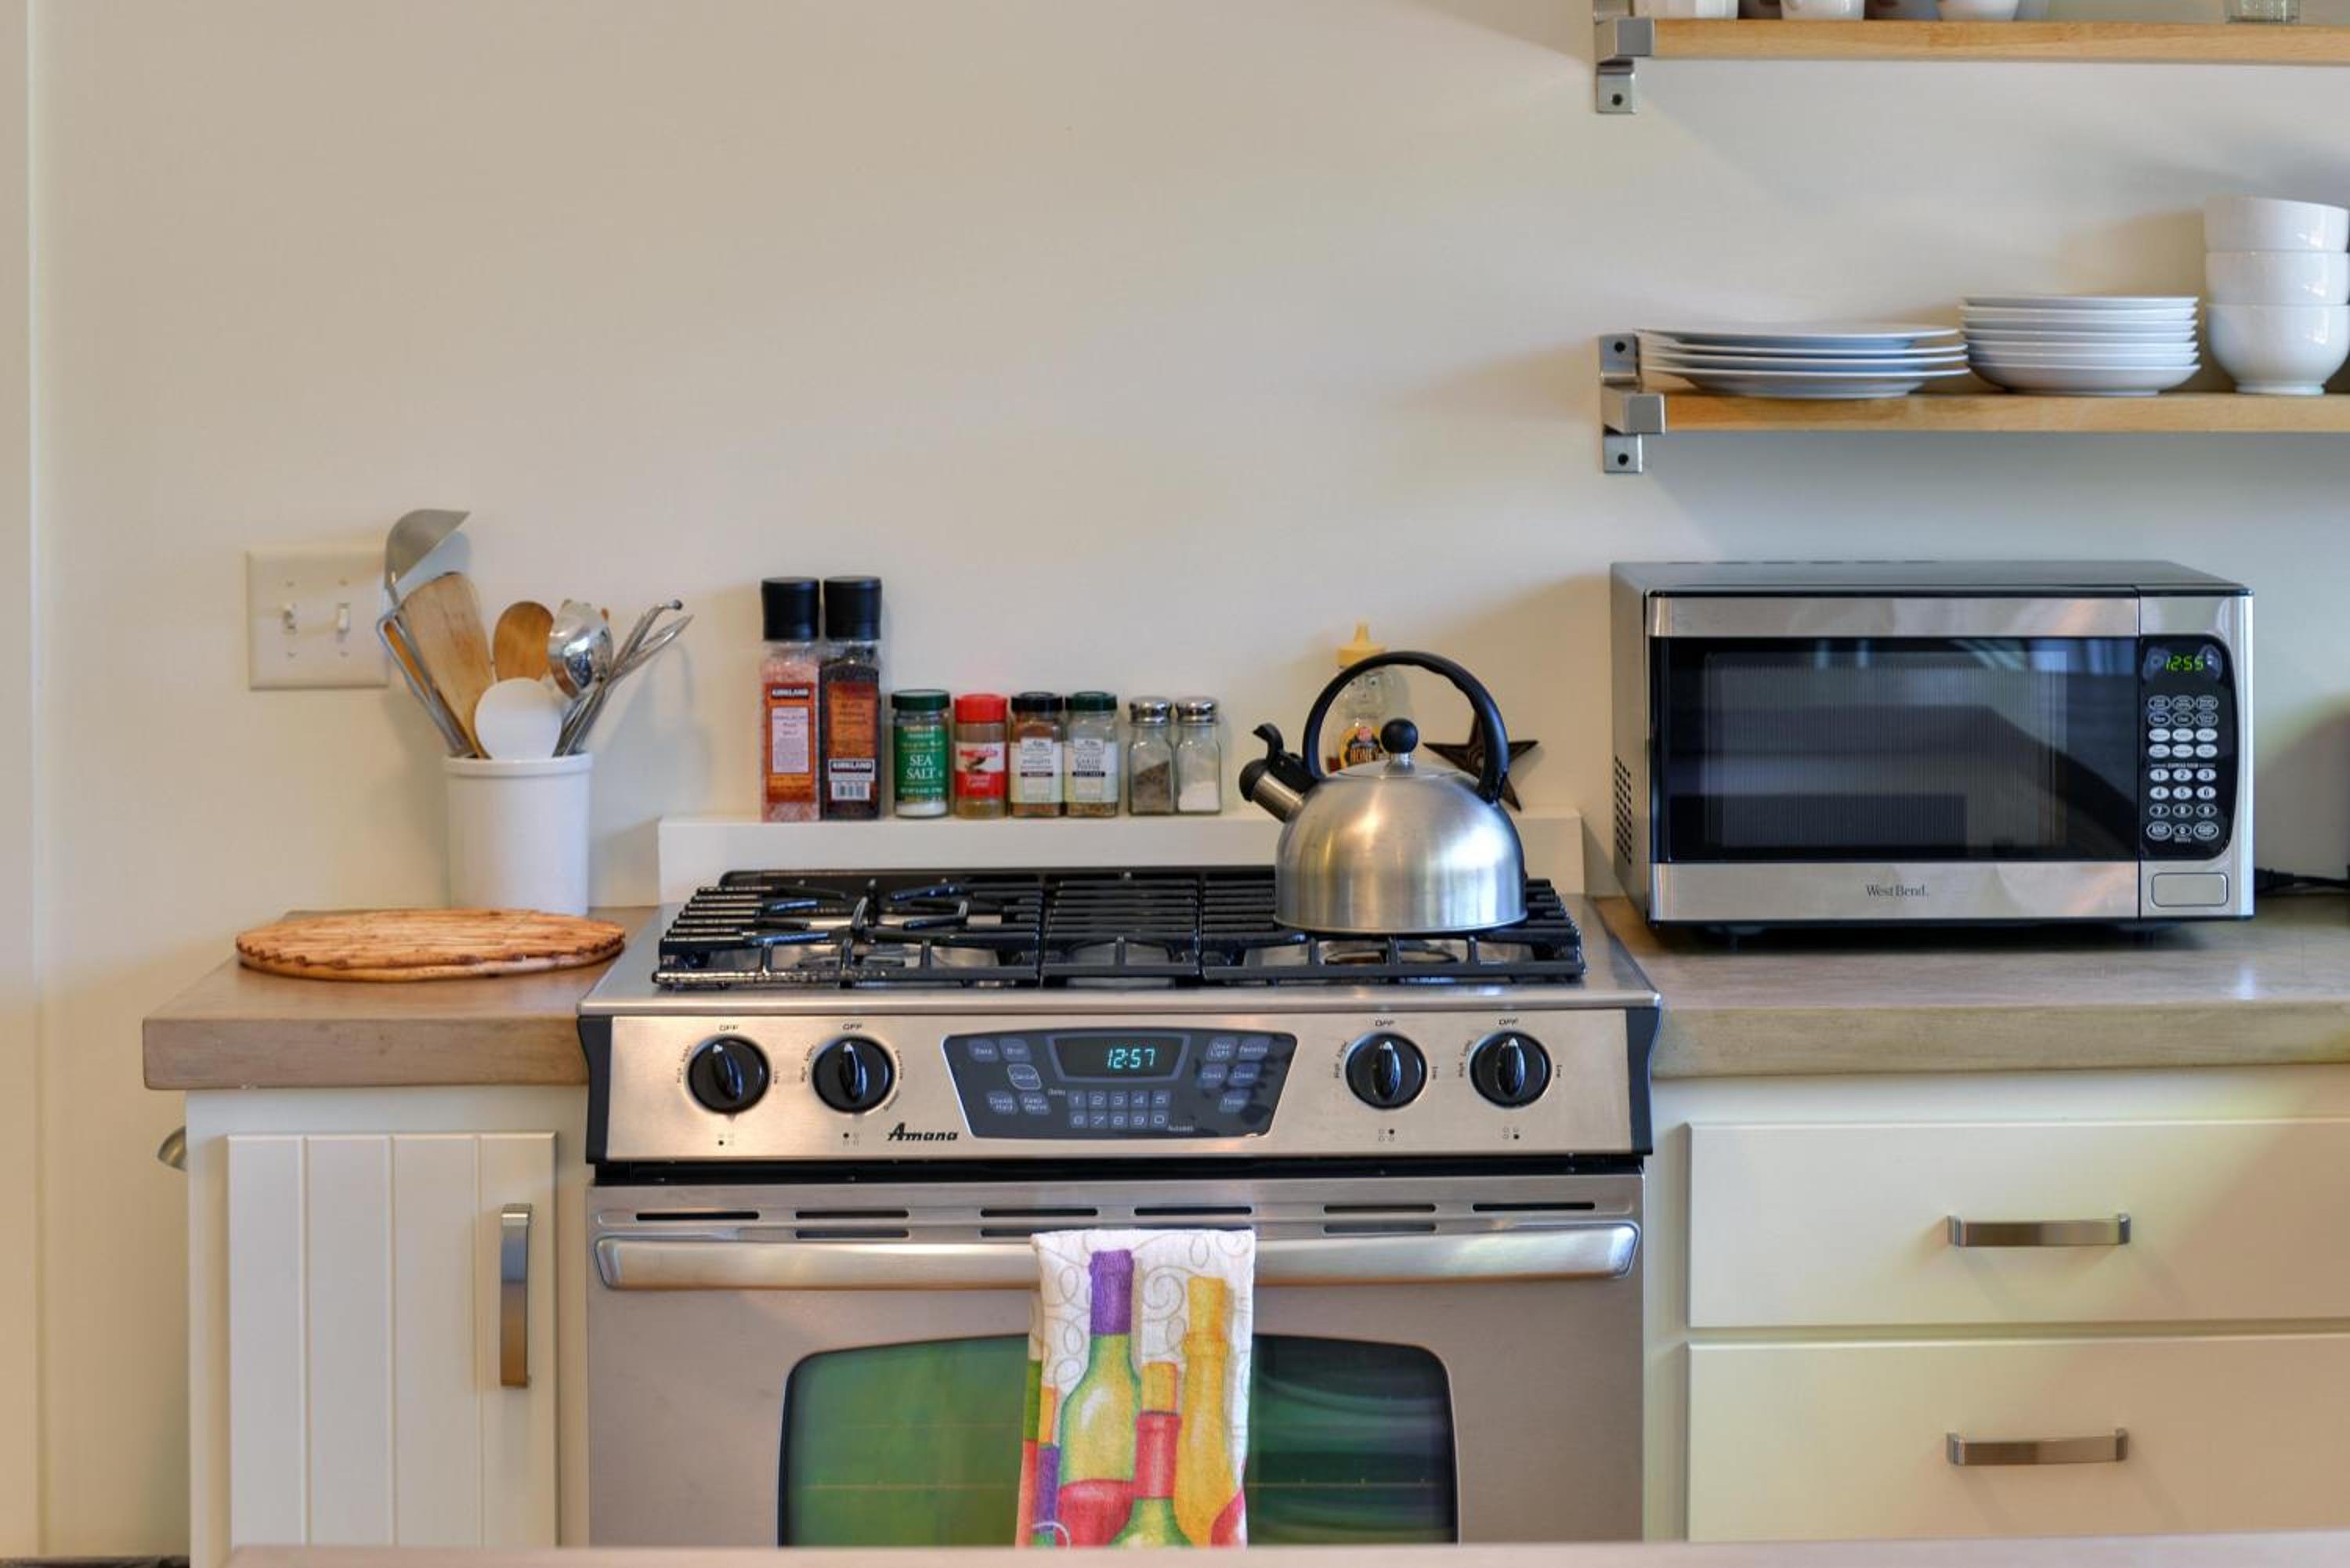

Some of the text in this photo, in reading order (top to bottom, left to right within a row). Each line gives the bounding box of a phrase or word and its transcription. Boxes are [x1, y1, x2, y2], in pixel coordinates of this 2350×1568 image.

[772, 688, 809, 697] KIRKLAND
[909, 754, 933, 766] SEA
[1350, 747, 1379, 764] HONEY
[832, 761, 873, 769] KIRKLAND
[906, 767, 936, 779] SALT
[2180, 770, 2186, 779] 2
[2204, 770, 2210, 779] 3
[2156, 788, 2210, 797] 4 5 6
[2157, 805, 2163, 815] 7
[1867, 883, 1893, 896] West
[1107, 1047, 1155, 1069] 12:57
[1092, 1097, 1104, 1105] 2
[1113, 1097, 1124, 1105] 3
[1073, 1115, 1165, 1126] 6 7 8 9 0
[886, 1121, 959, 1141] Amana
